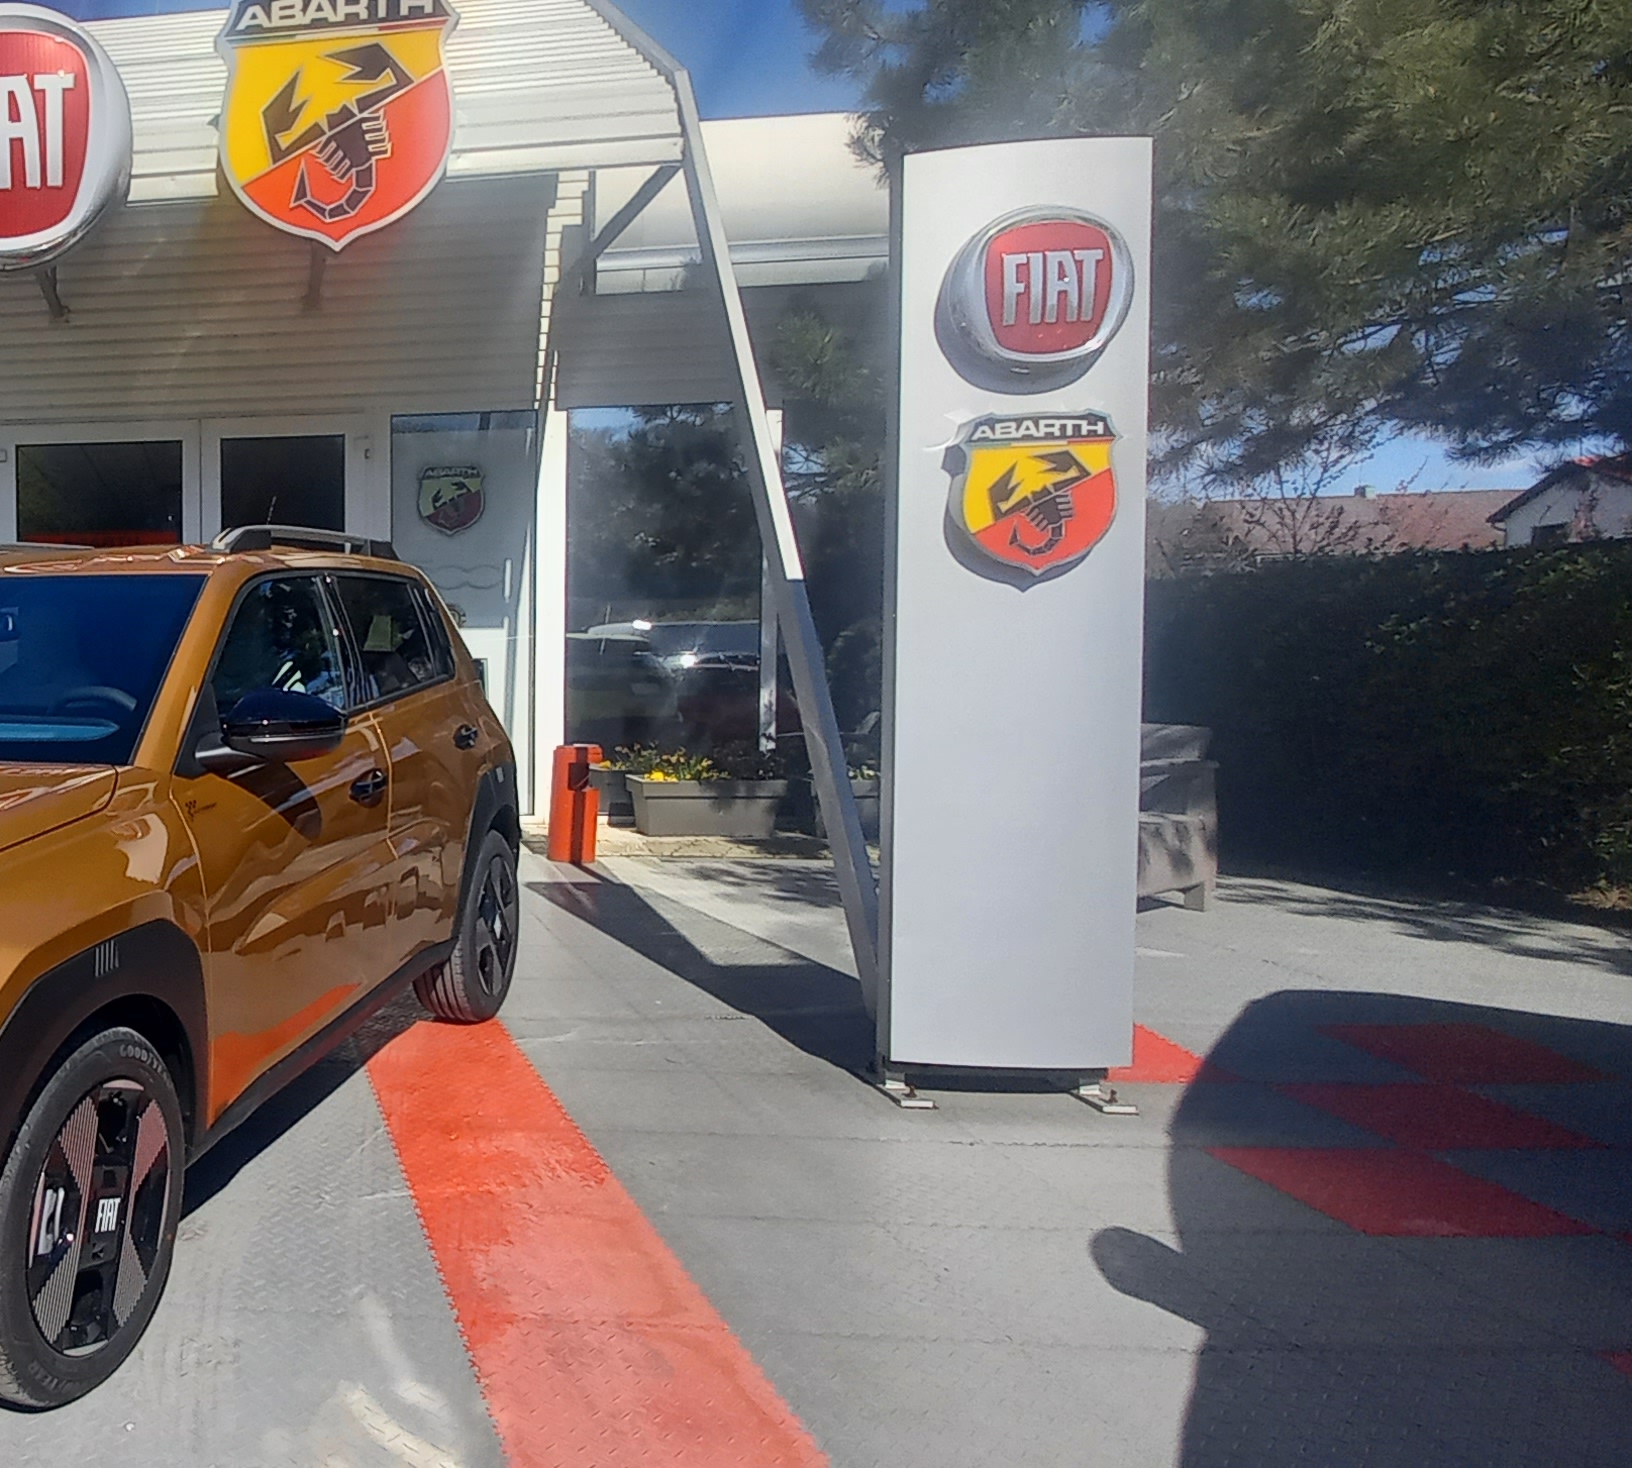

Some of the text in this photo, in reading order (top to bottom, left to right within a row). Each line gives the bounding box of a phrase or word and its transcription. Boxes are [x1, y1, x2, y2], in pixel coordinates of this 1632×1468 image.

[1001, 248, 1104, 326] FIAT
[971, 419, 1105, 440] ABARTH
[94, 1197, 121, 1234] FIAT
